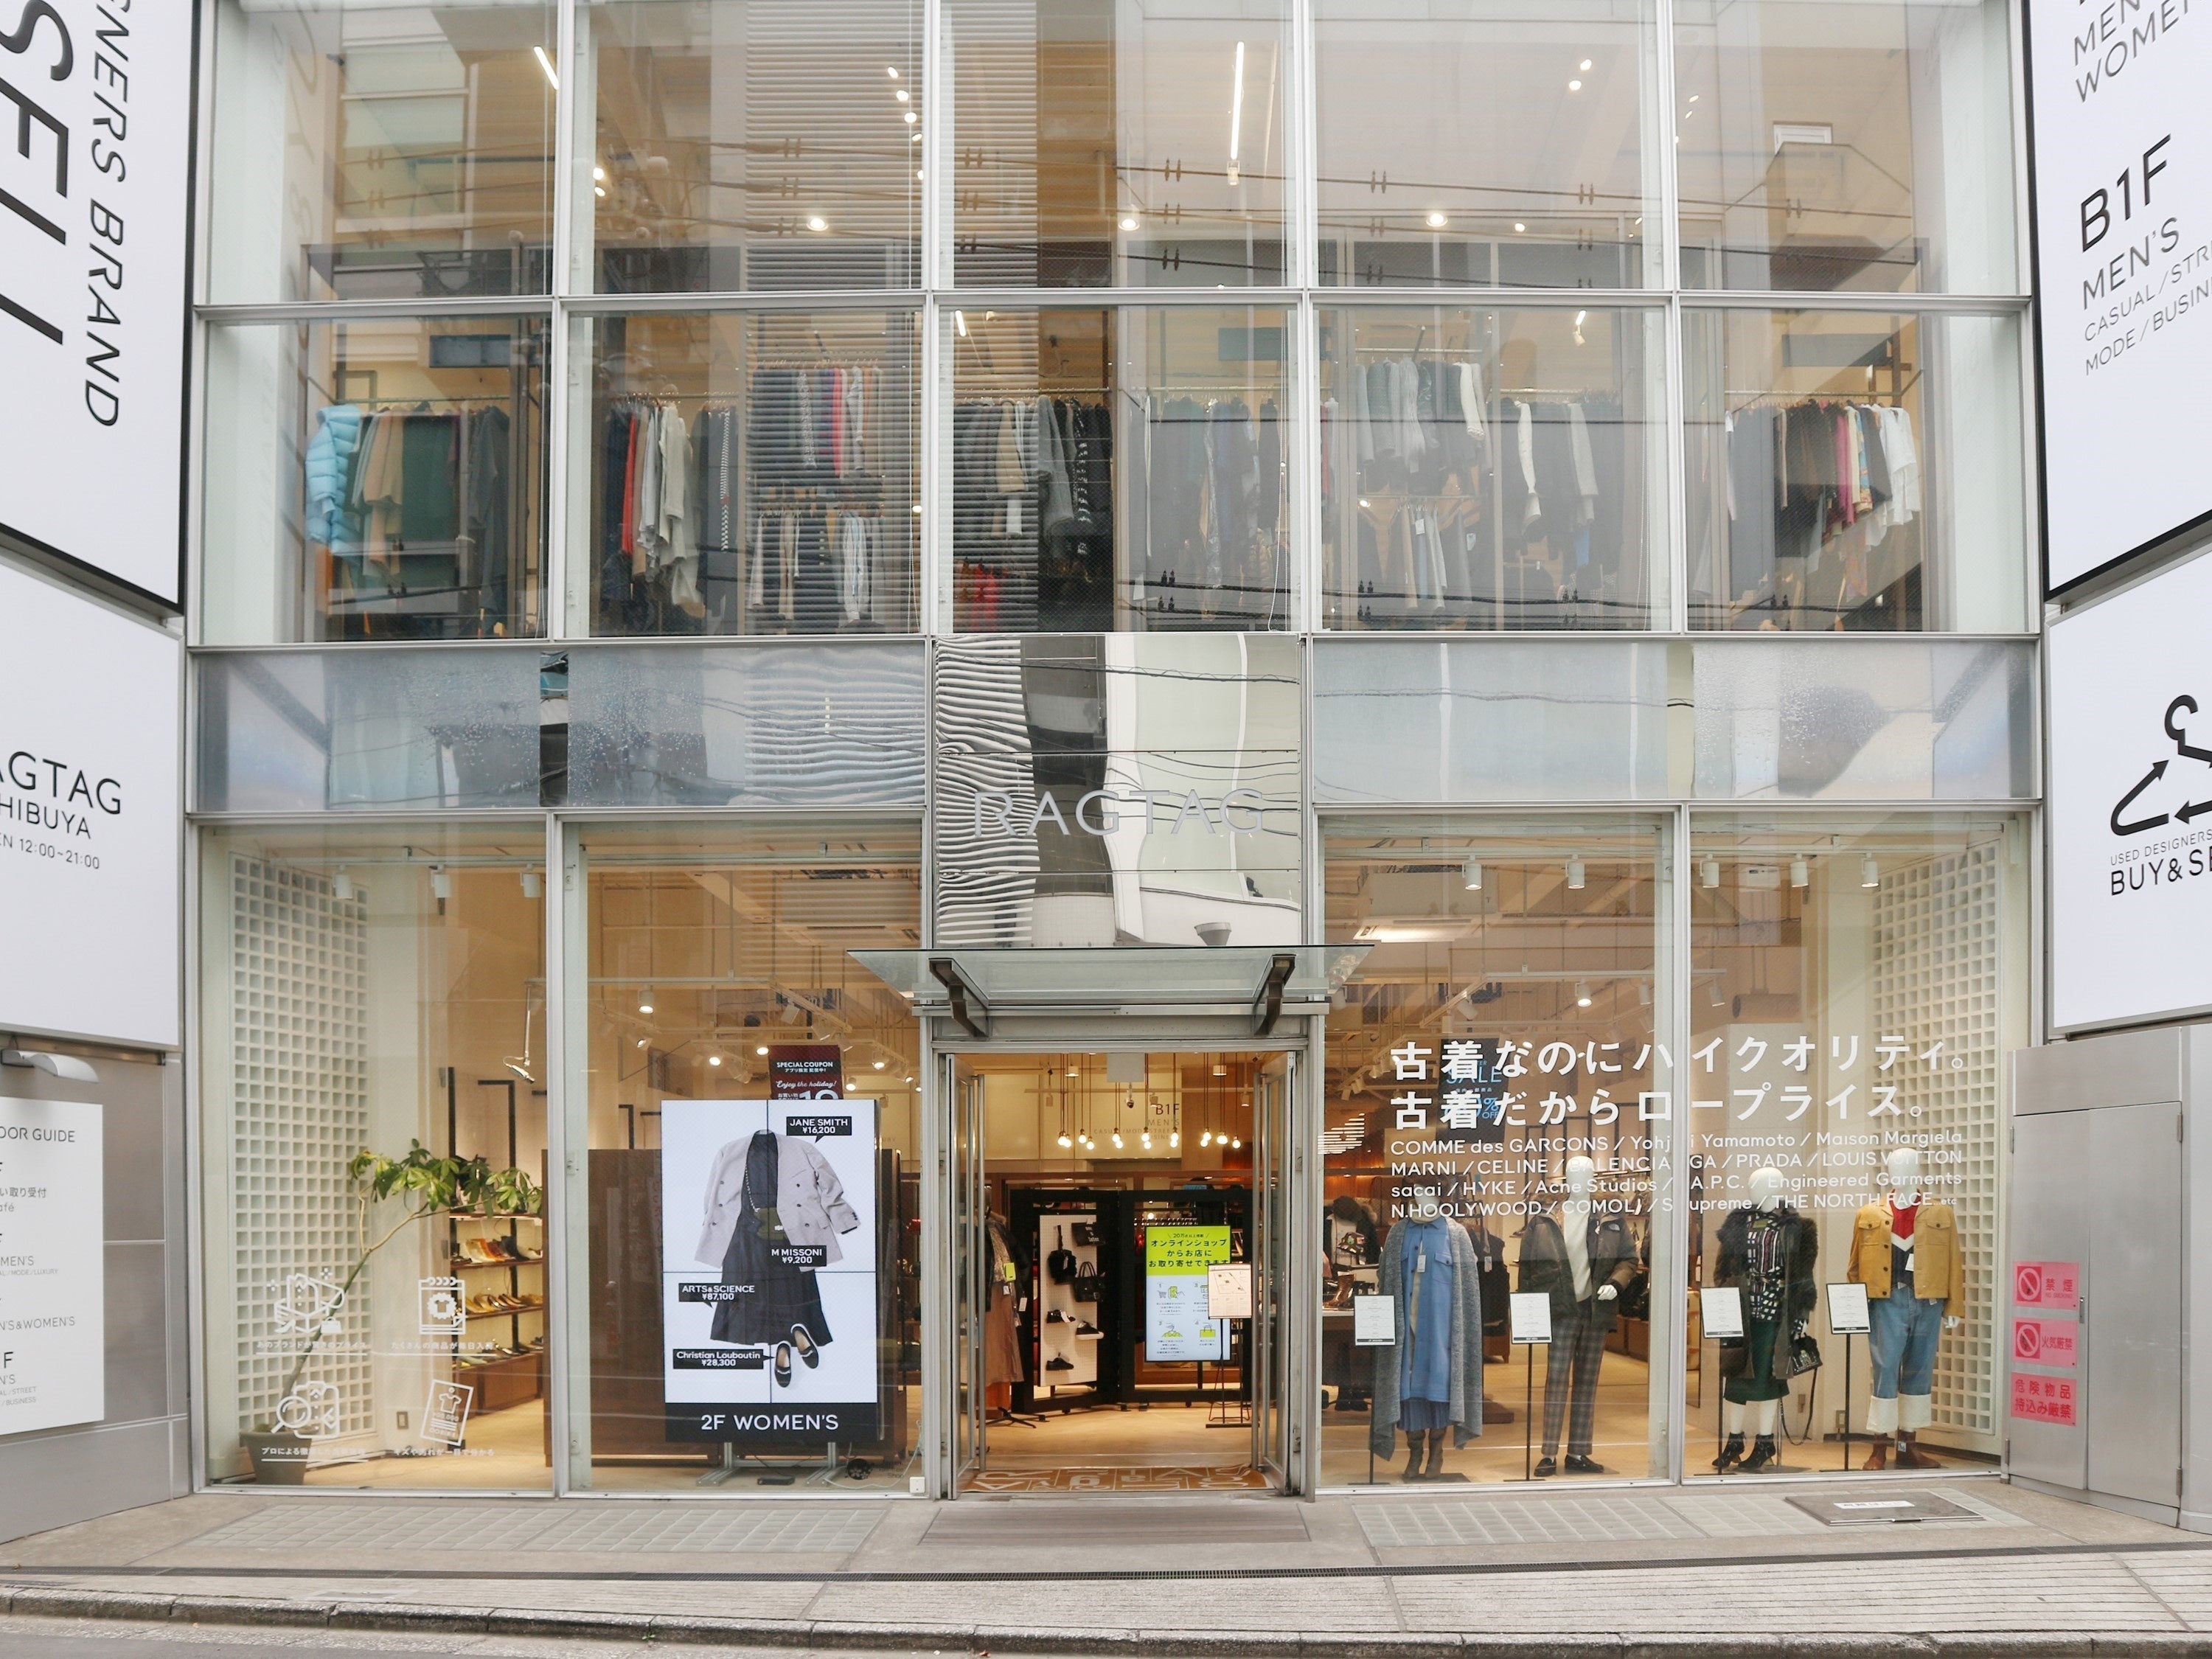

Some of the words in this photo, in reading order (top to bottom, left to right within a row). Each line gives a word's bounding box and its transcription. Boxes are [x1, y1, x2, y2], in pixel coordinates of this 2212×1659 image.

[2076, 0, 2188, 102] WOME
[91, 0, 131, 183] NERS
[2080, 133, 2171, 253] B1F
[2083, 217, 2180, 310] MEN'S
[85, 198, 124, 427] BRAND
[0, 751, 121, 815] GTAG
[974, 788, 1263, 837] RAGTAG
[2110, 849, 2140, 866] USED
[2111, 846, 2212, 896] BUY&S
[1390, 1034, 1964, 1081] 古着なのにハイクオリティ。
[776, 1080, 796, 1089] Enjoy
[1155, 1103, 1180, 1115] B1F
[32, 1128, 75, 1142] GUIDE
[1390, 1139, 1466, 1155] COMME
[1470, 1138, 1504, 1154] des
[1509, 1136, 1608, 1153] GARCONS
[1701, 1133, 1795, 1148] Yamamoto
[1816, 1131, 1879, 1146] Maison
[1885, 1129, 1963, 1148] Margiela
[1391, 1161, 1457, 1176] MARNI
[1477, 1158, 1548, 1175] CELINE
[1736, 1152, 1803, 1167] PRADA
[1823, 1152, 1877, 1166] LOUIS
[1391, 1182, 1441, 1198] sacai
[1463, 1180, 1516, 1195] HYKE
[1535, 1179, 1582, 1194] Acne
[1587, 1178, 1657, 1193] Studios
[1690, 1175, 1745, 1189] A.P.C.
[1767, 1172, 1868, 1192] Engineered
[1876, 1172, 1962, 1186] Garments
[1391, 1200, 1543, 1218] N.HOOLYWOOD
[1772, 1194, 1808, 1208] THE
[1814, 1193, 1882, 1208] NORTH
[1150, 1239, 1227, 1247] オンラインショップ
[1167, 1249, 1213, 1258] からお店に
[676, 1351, 715, 1359] Christian
[717, 1351, 760, 1359] Louboutin
[701, 1359, 736, 1367] ¥28,300
[701, 1414, 726, 1430] 2F
[733, 1413, 839, 1430] WOMEN'S
